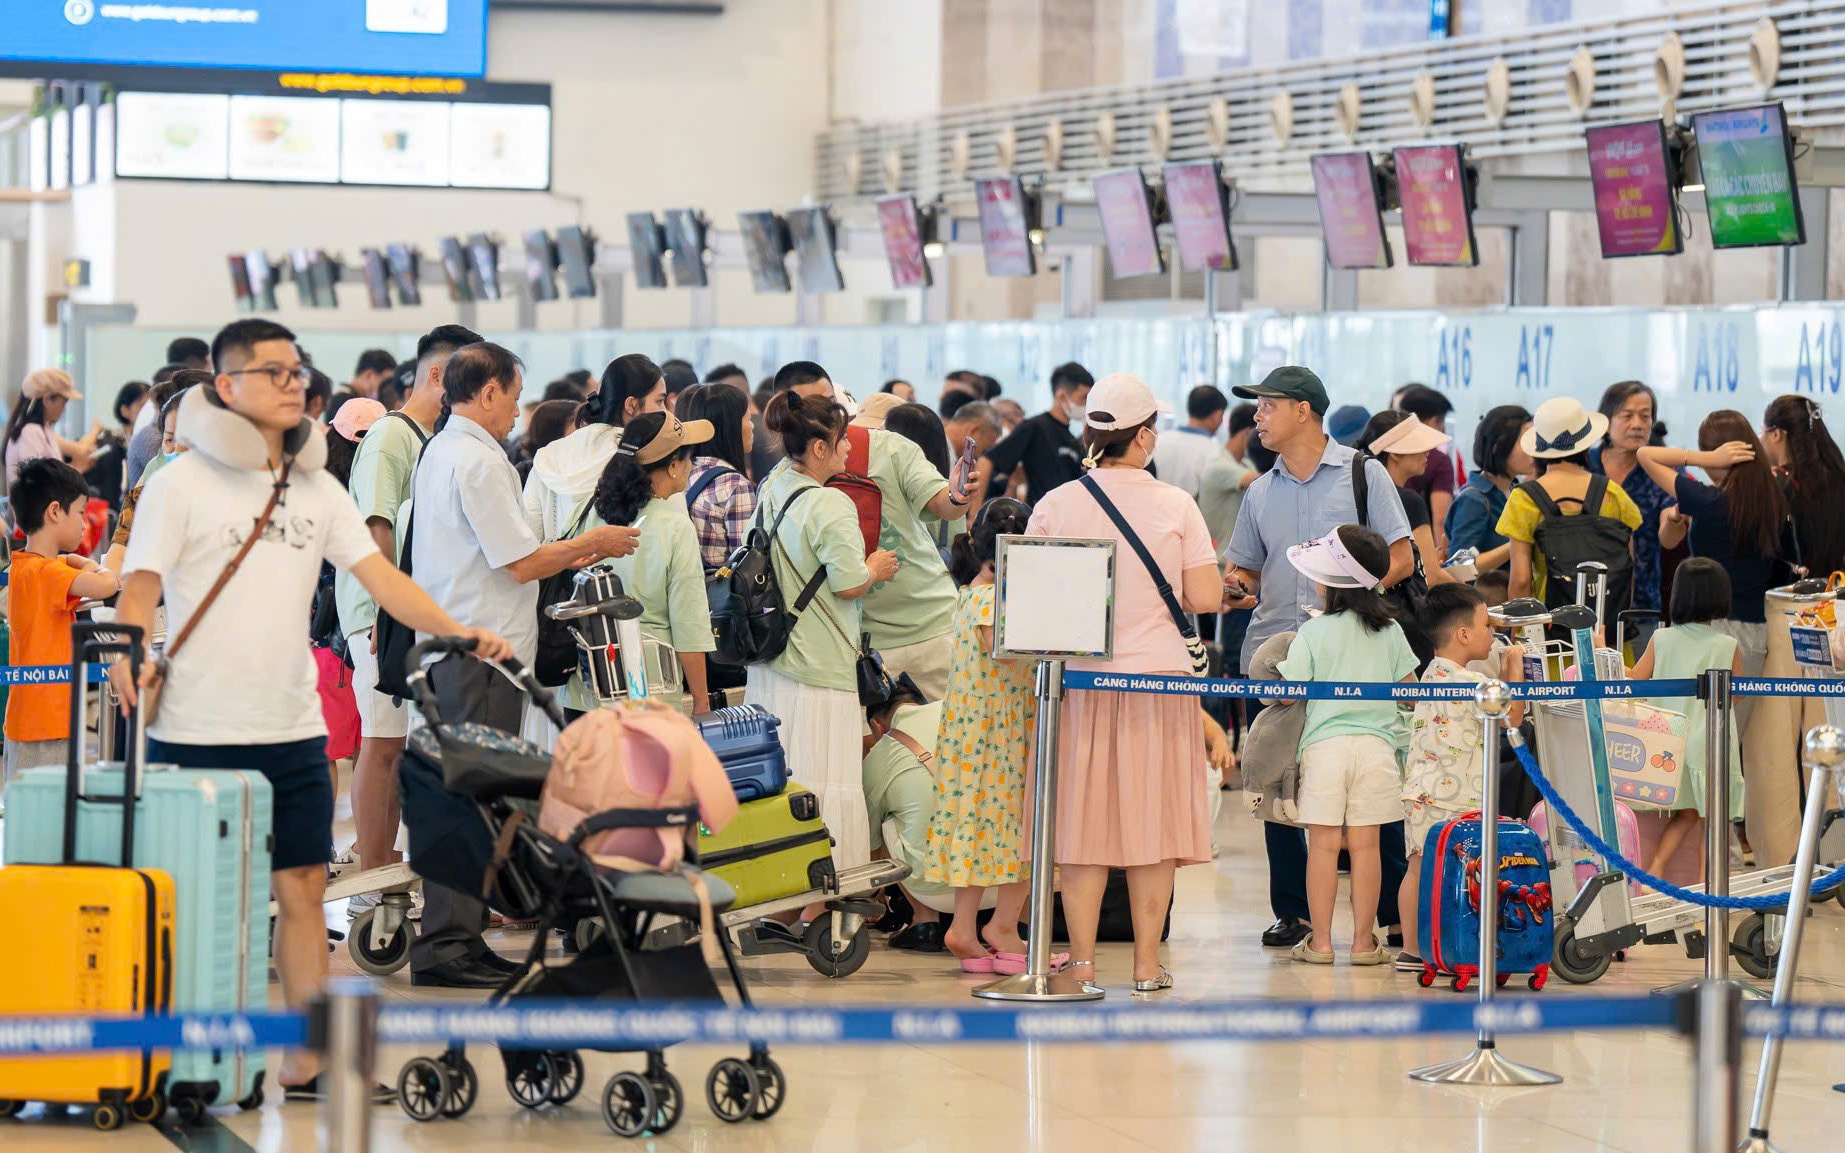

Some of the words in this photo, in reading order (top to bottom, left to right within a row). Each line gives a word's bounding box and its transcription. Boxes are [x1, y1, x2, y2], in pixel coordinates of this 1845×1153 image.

[1436, 326, 1472, 387] A16
[1516, 325, 1554, 387] A17
[1694, 322, 1738, 392] A18
[1795, 321, 1842, 393] A19
[5, 667, 20, 682] TẾ
[23, 668, 45, 683] NỘI
[1167, 680, 1208, 692] KHÔNG
[1211, 681, 1245, 693] QUỐC
[1248, 682, 1262, 694] TẾ
[1264, 684, 1285, 697] NỘI
[1288, 684, 1307, 696] BÀI
[1334, 686, 1362, 697] N.I.A
[1391, 687, 1430, 697] NOIBAI
[1433, 686, 1524, 697] INTERNAL
[1527, 686, 1576, 696] AIRPORT
[1605, 685, 1632, 695] N.I.A
[1774, 681, 1816, 693] KHÔNG
